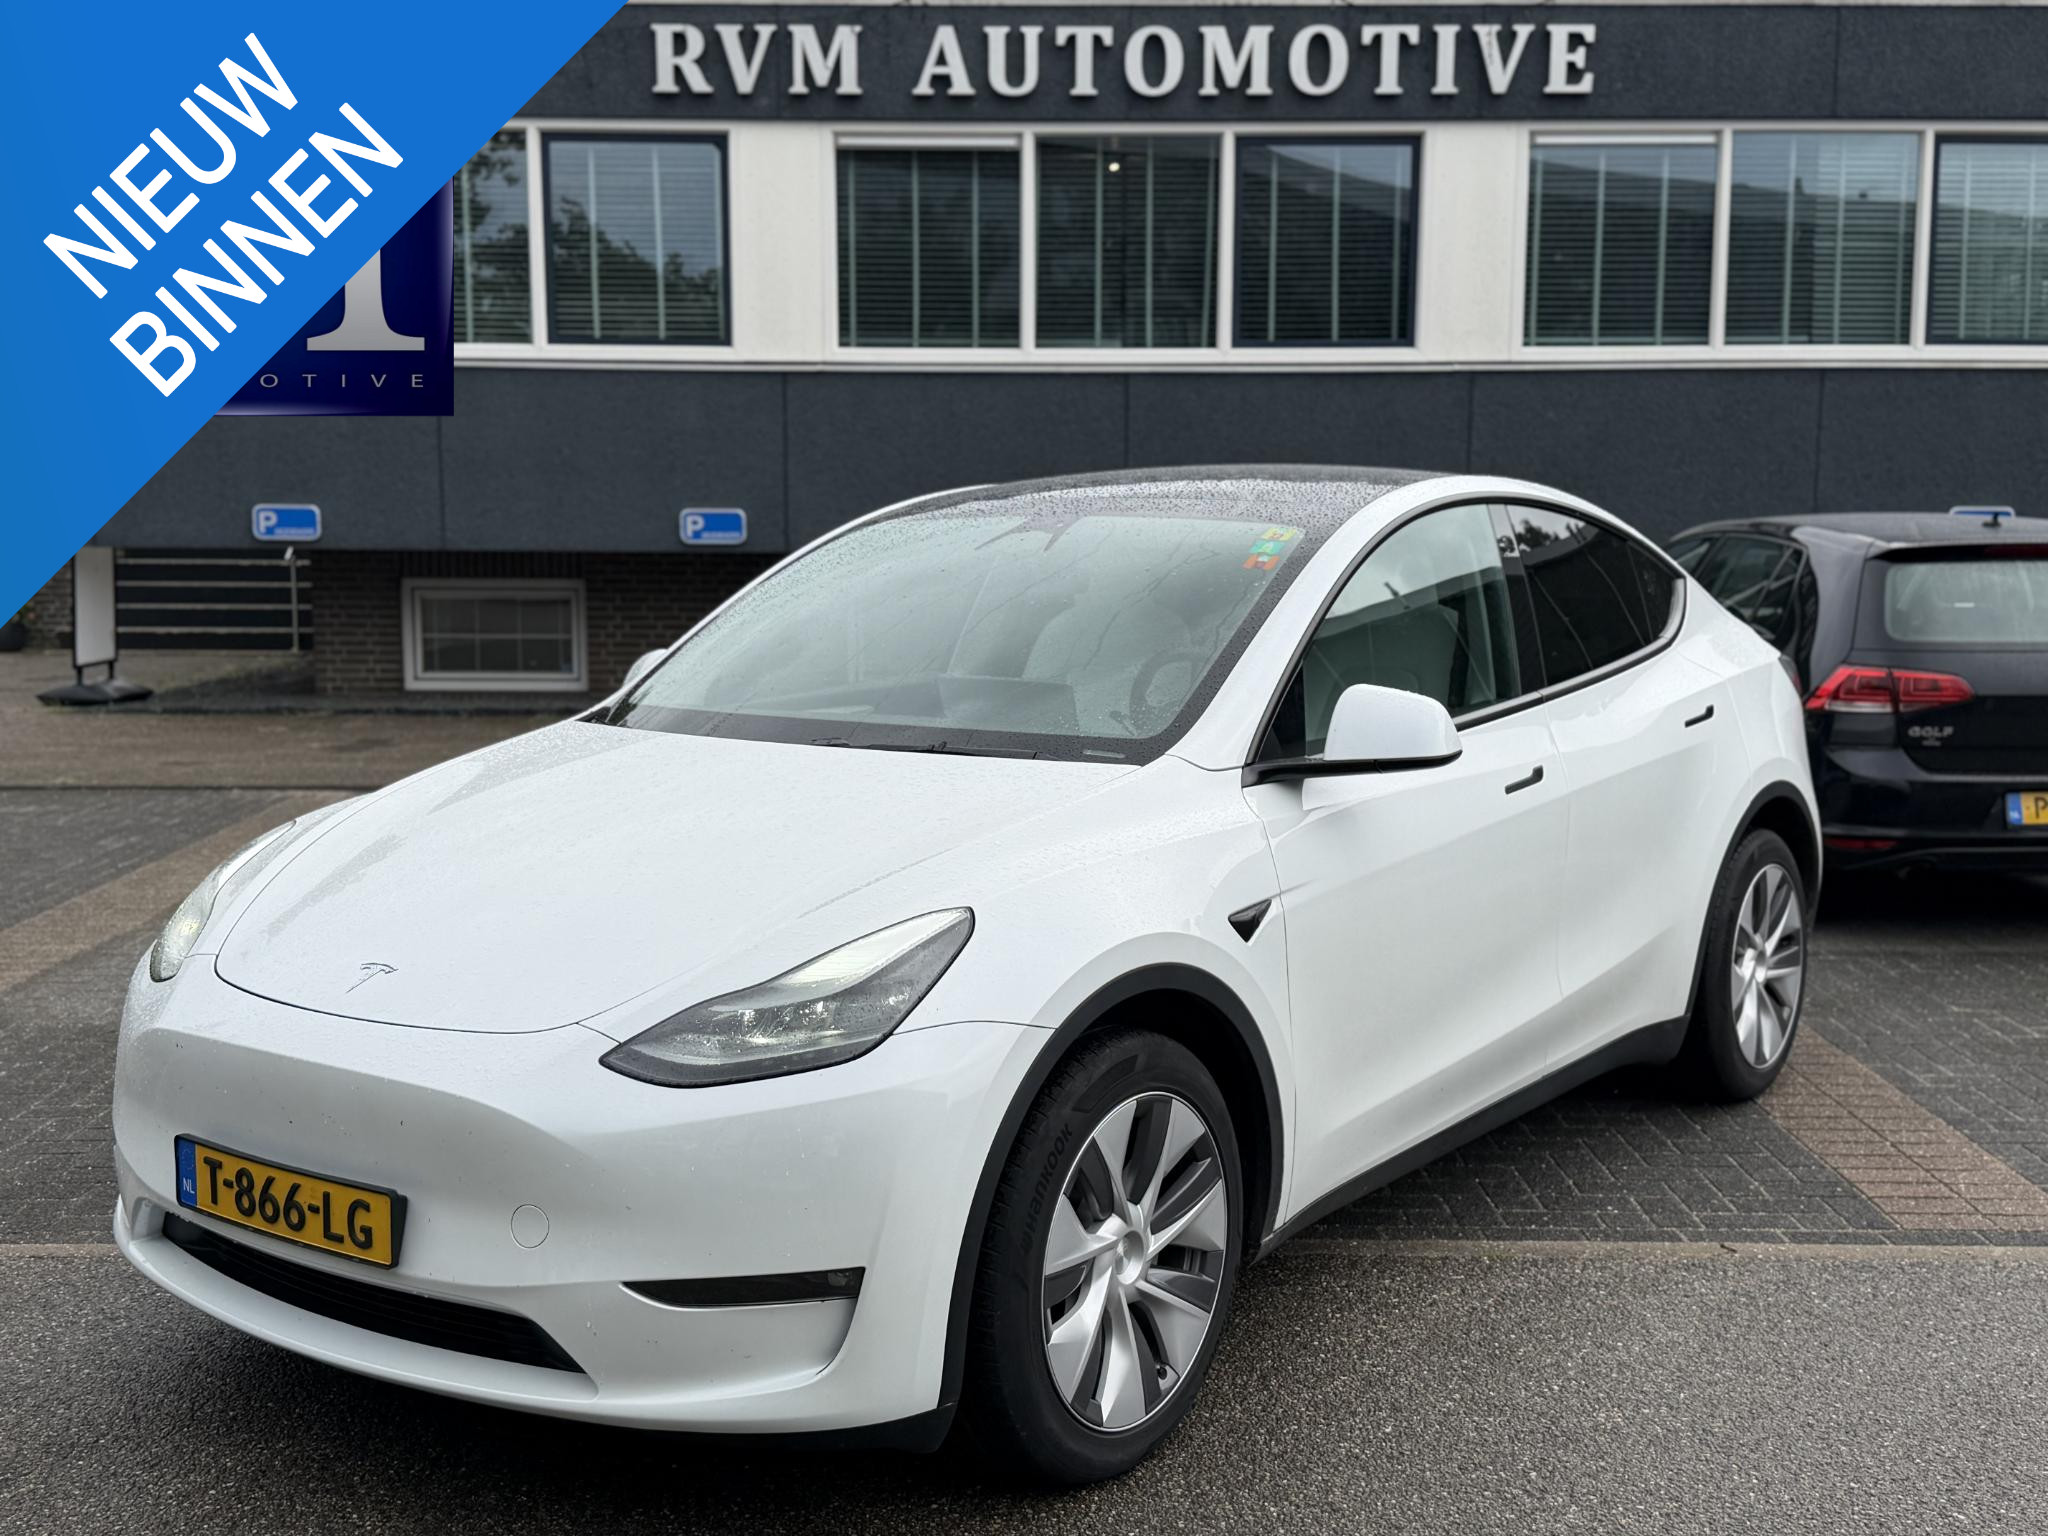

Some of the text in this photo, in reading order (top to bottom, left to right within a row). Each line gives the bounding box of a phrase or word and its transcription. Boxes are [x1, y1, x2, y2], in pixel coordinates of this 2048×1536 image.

[650, 22, 1597, 96] RVM AUTOMOTIVE
[1908, 726, 1954, 737] GOLF
[183, 1178, 195, 1194] NL
[203, 1156, 373, 1249] T-866-LG
